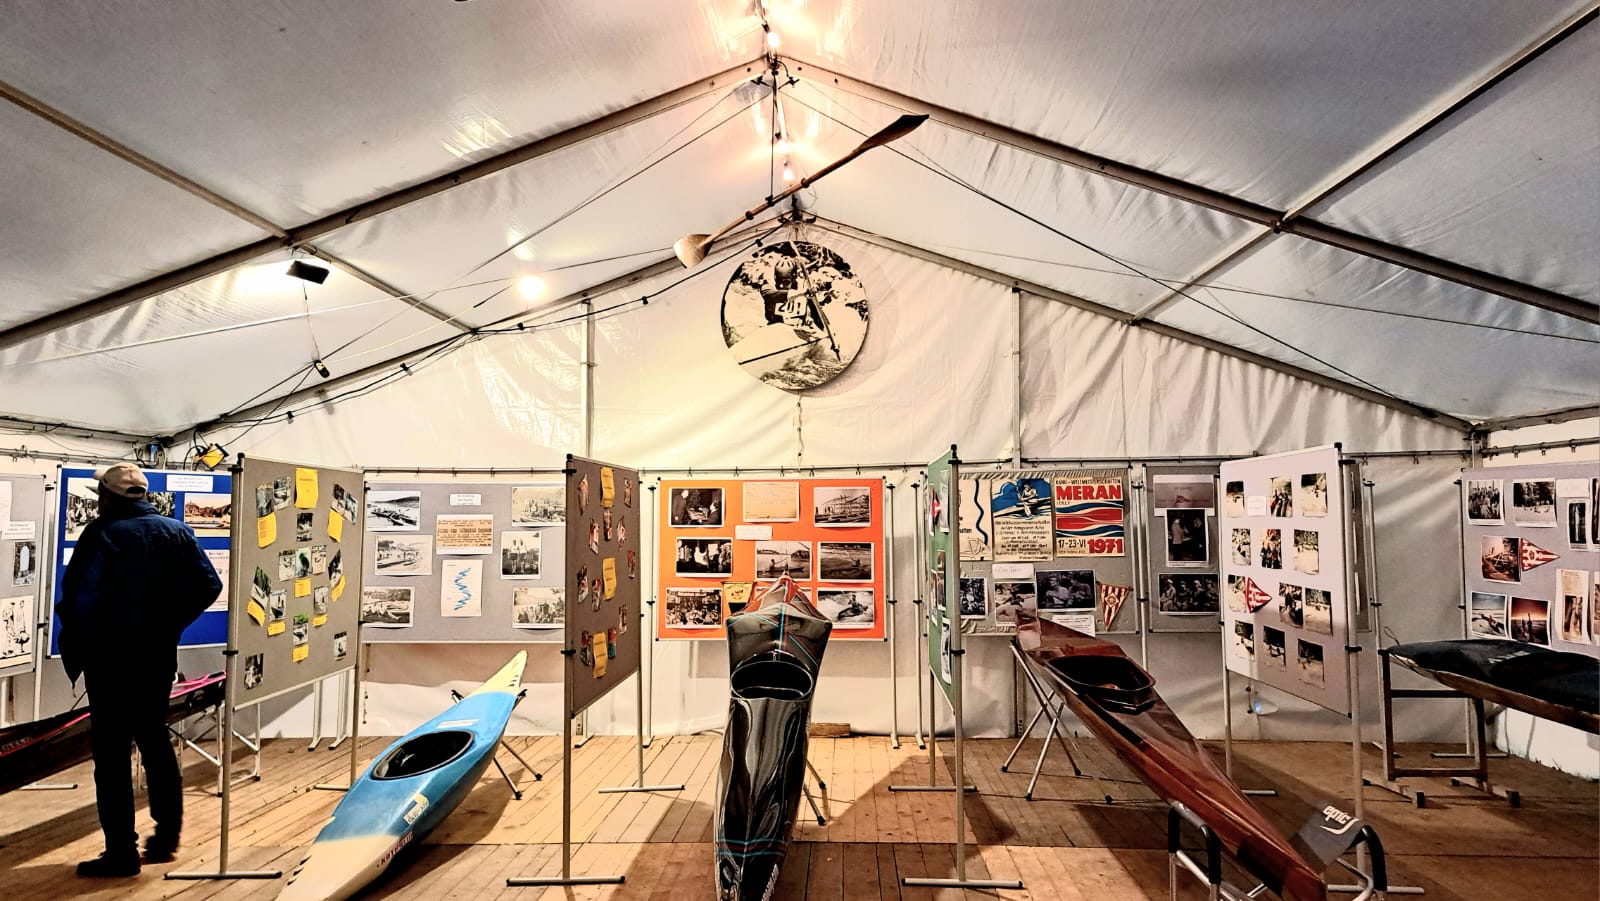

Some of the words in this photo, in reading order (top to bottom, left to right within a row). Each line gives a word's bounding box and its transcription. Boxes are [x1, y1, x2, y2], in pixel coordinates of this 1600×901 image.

[1056, 485, 1121, 500] MERAN
[1088, 539, 1123, 554] 1971
[1323, 805, 1351, 824] epic
